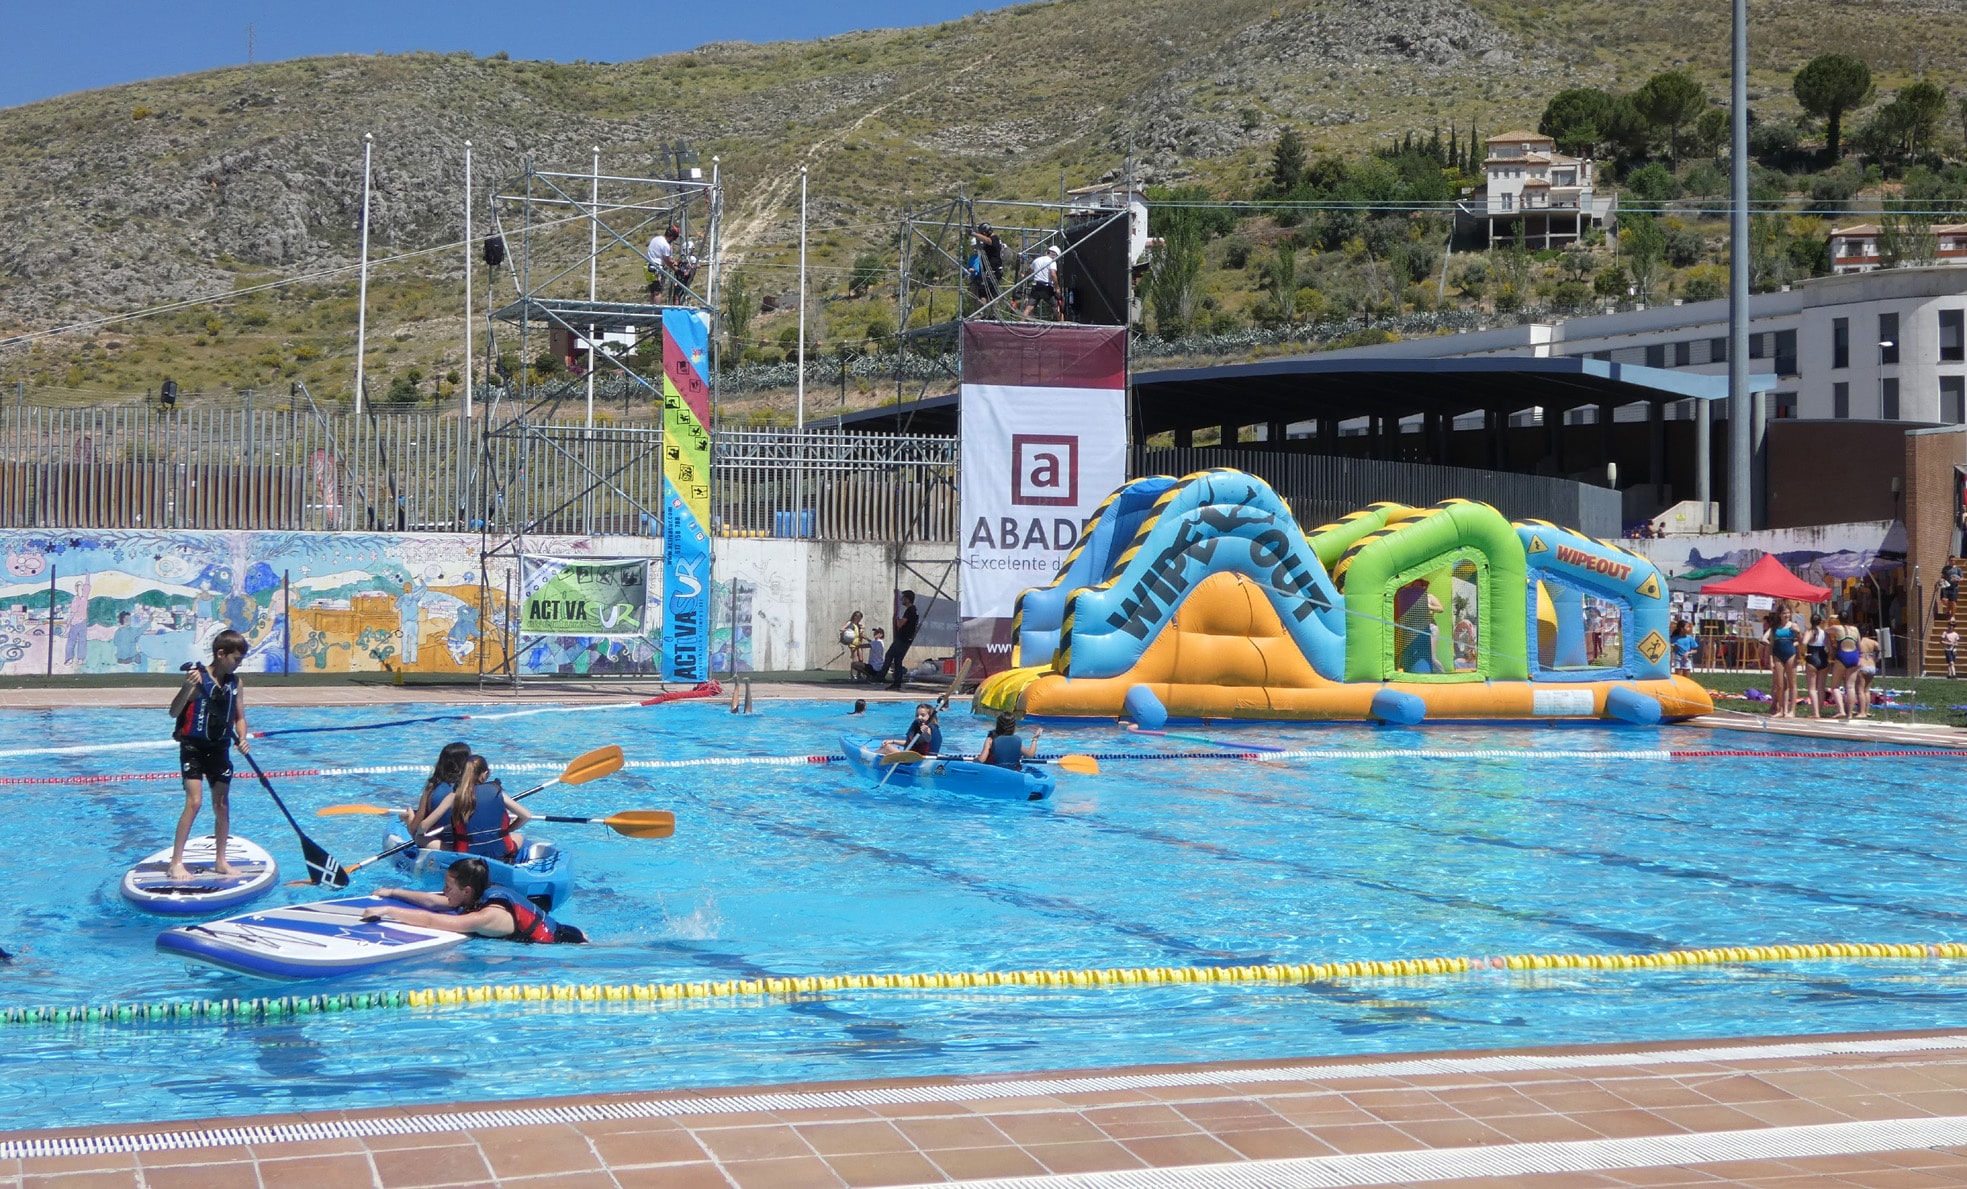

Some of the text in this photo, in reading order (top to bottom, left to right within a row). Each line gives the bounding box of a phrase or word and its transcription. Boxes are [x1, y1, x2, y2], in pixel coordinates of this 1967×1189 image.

[970, 554, 1046, 571] Excelente
[1106, 519, 1332, 641] WIPE OUT
[1556, 543, 1633, 582] WIPEOUT
